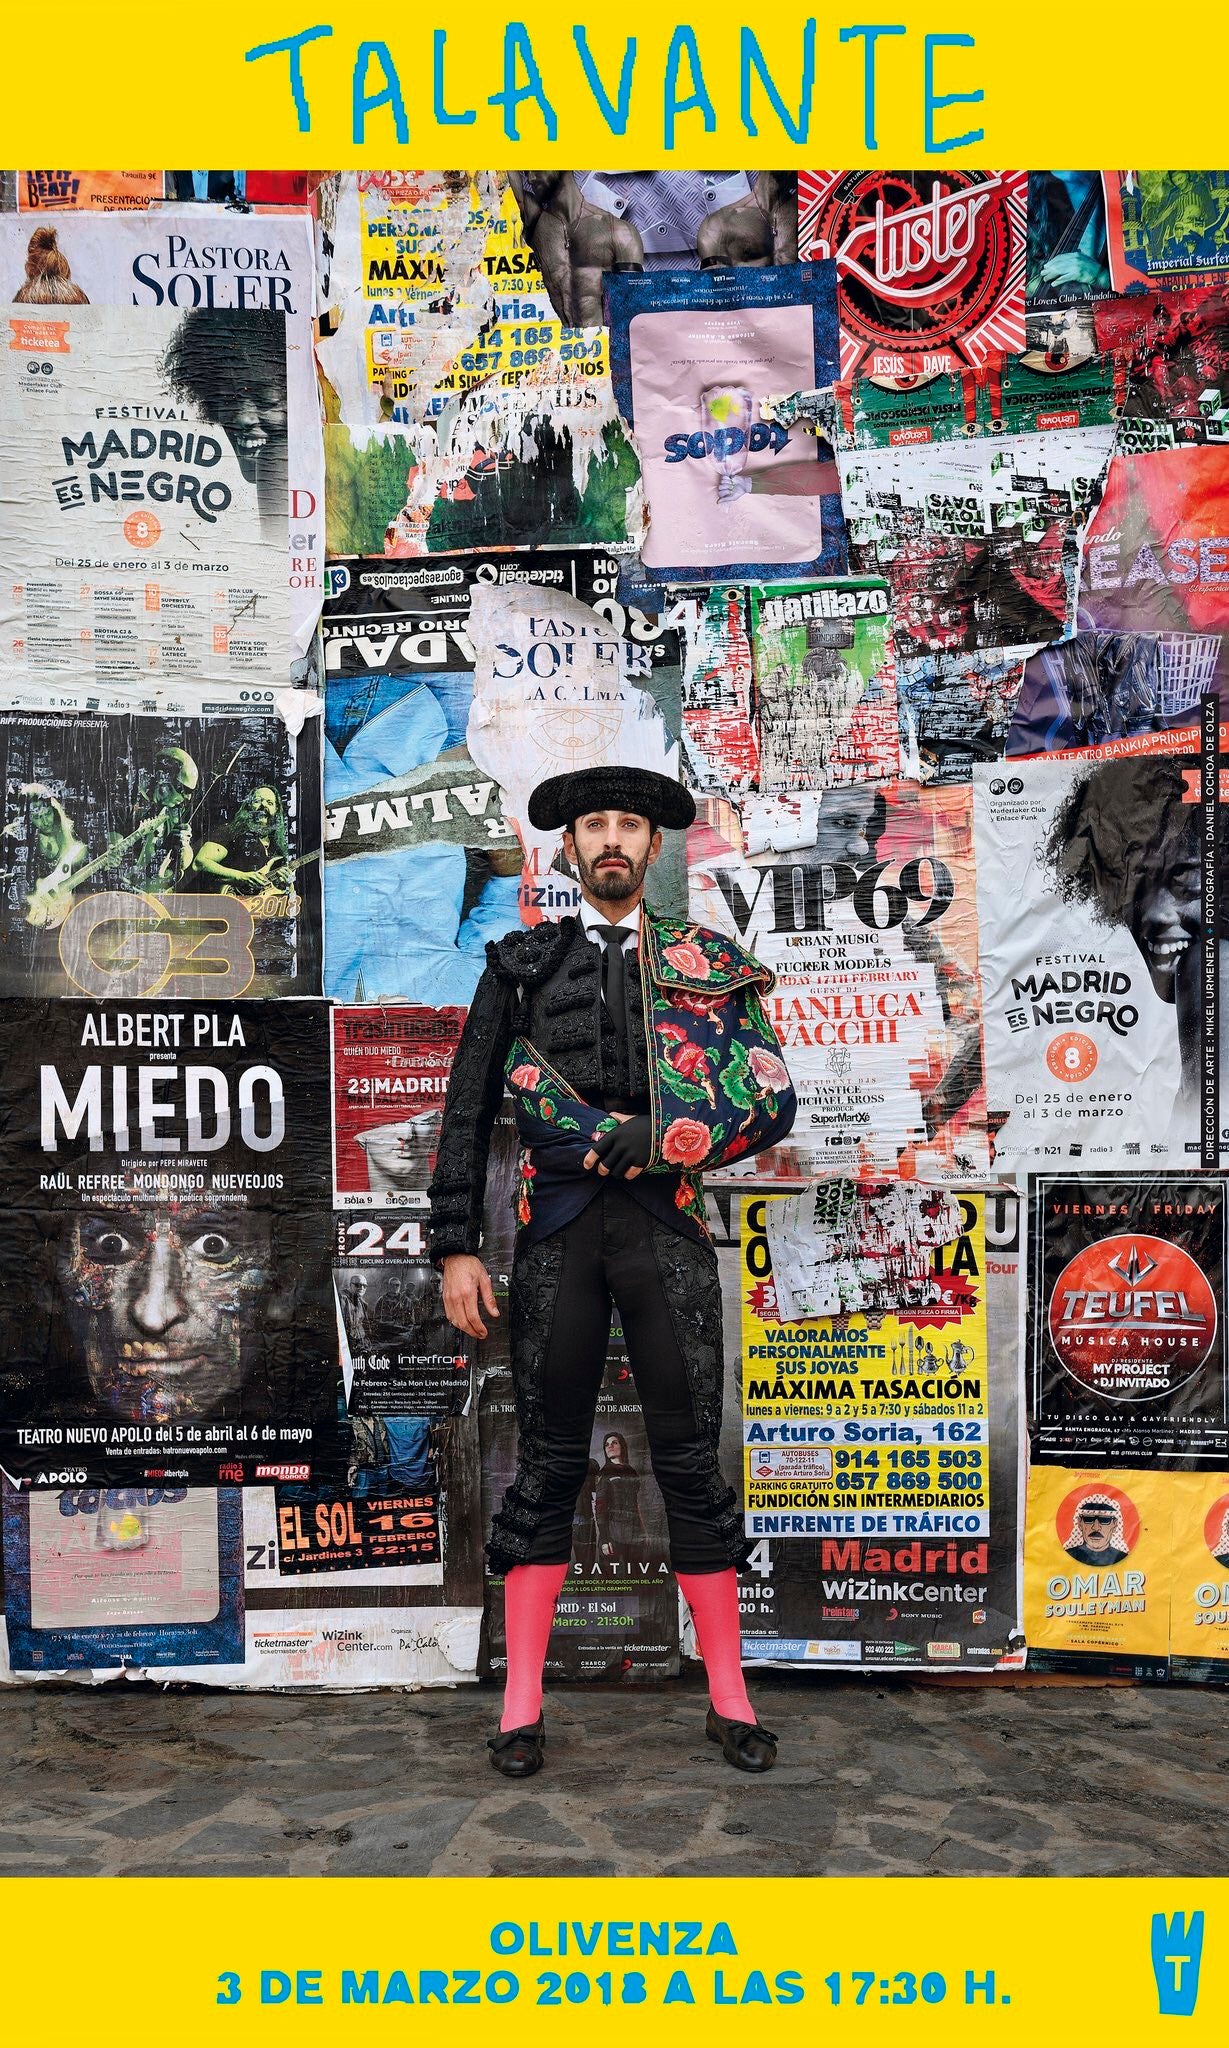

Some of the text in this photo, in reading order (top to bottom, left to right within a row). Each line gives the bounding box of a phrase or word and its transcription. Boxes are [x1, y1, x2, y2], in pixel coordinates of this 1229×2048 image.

[28, 181, 80, 208] BEAT!
[166, 235, 292, 270] PASTORA
[1147, 253, 1193, 269] Imperial
[132, 253, 297, 314] SOLER
[1032, 294, 1077, 305] Lovers Club
[21, 337, 60, 348] ticketea
[873, 355, 904, 374] JESÚS
[924, 355, 950, 373] DAVE
[95, 407, 188, 420] FESTIVAL
[62, 428, 222, 469] MADRID
[664, 423, 793, 463] todos
[56, 470, 232, 523] ES NEGRO
[136, 521, 149, 538] 8
[55, 557, 229, 572] Del 25 de enero al 3 de marzo
[361, 571, 461, 585] agoraespectaculos.es
[501, 569, 563, 583] ticketbell
[765, 589, 888, 620] gatillazo
[18, 718, 109, 728] PRODUCCIONES PRESENTA:
[1105, 739, 1150, 757] BANKIA
[1170, 745, 1195, 756] 19:00
[708, 857, 954, 938] VIP69
[251, 895, 301, 918] 2018
[786, 933, 879, 948] URBAN MUSIC
[819, 948, 846, 958] FOR
[1036, 954, 1105, 966] FESTIVAL
[776, 958, 892, 972] FUCKER MODELS
[816, 970, 920, 984] 17TH FEBRUARY
[1011, 970, 1132, 1002] MADRID
[1008, 1000, 1139, 1037] ES NEGRO
[81, 1013, 245, 1047] ALBERT PLA
[771, 1020, 899, 1047] VACCHI
[150, 1052, 176, 1062] presenta
[1065, 1047, 1081, 1069] 8
[815, 1086, 861, 1094] YASTICE
[1015, 1092, 1132, 1104] Del 25 de enero
[849, 1094, 885, 1103] KROSS
[40, 1065, 285, 1152] MIEDO
[1024, 1107, 1124, 1118] al 3 de marzo
[40, 1171, 284, 1189] RAÜL REFREE MONDONGO NUEVEOJOS
[1053, 1205, 1217, 1215] VIERNES FRIDAY
[347, 1222, 426, 1256] 24
[986, 1262, 1018, 1275] Tour
[1062, 1291, 1206, 1322] TEUFEL
[765, 1328, 868, 1343] VALORAMOS
[1062, 1334, 1200, 1346] MÚSICA HOUSE
[398, 1354, 469, 1364] Interfront
[749, 1345, 886, 1359] PERSONALMENTE
[776, 1361, 859, 1375] SUS JOYAS
[1093, 1364, 1170, 1375] MY PROJECT
[748, 1376, 980, 1400] MÁXIMA TASACIÓN
[1100, 1378, 1170, 1388] DJ INVITADO
[17, 1426, 313, 1445] TEATRO NUEVO APOLO del 5 de abril al 6 de mayo
[747, 1422, 982, 1446] Arturo Soria, 162
[835, 1450, 982, 1468] 914 165 503
[750, 1482, 834, 1490] PARKING GRATUITO
[836, 1472, 982, 1490] 657 869 500
[367, 1497, 434, 1511] VIERNES
[749, 1490, 984, 1508] FUNDICIÓN SIN INTERMEDIARIOS
[279, 1502, 362, 1550] EL SOL
[369, 1512, 435, 1531] 16
[752, 1512, 980, 1532] ENFRENTE DE TRÁFICO
[369, 1531, 437, 1543] FEBRERO
[371, 1543, 434, 1555] 22:15
[821, 1539, 989, 1574] Madrid
[822, 1578, 989, 1603] WiZinkCenter
[1047, 1570, 1146, 1600] OMAR
[1046, 1600, 1145, 1617] SOULEYMAN
[254, 1638, 309, 1648] ticketmaster
[322, 1630, 363, 1641] WiZink
[337, 1641, 393, 1652] Center.com
